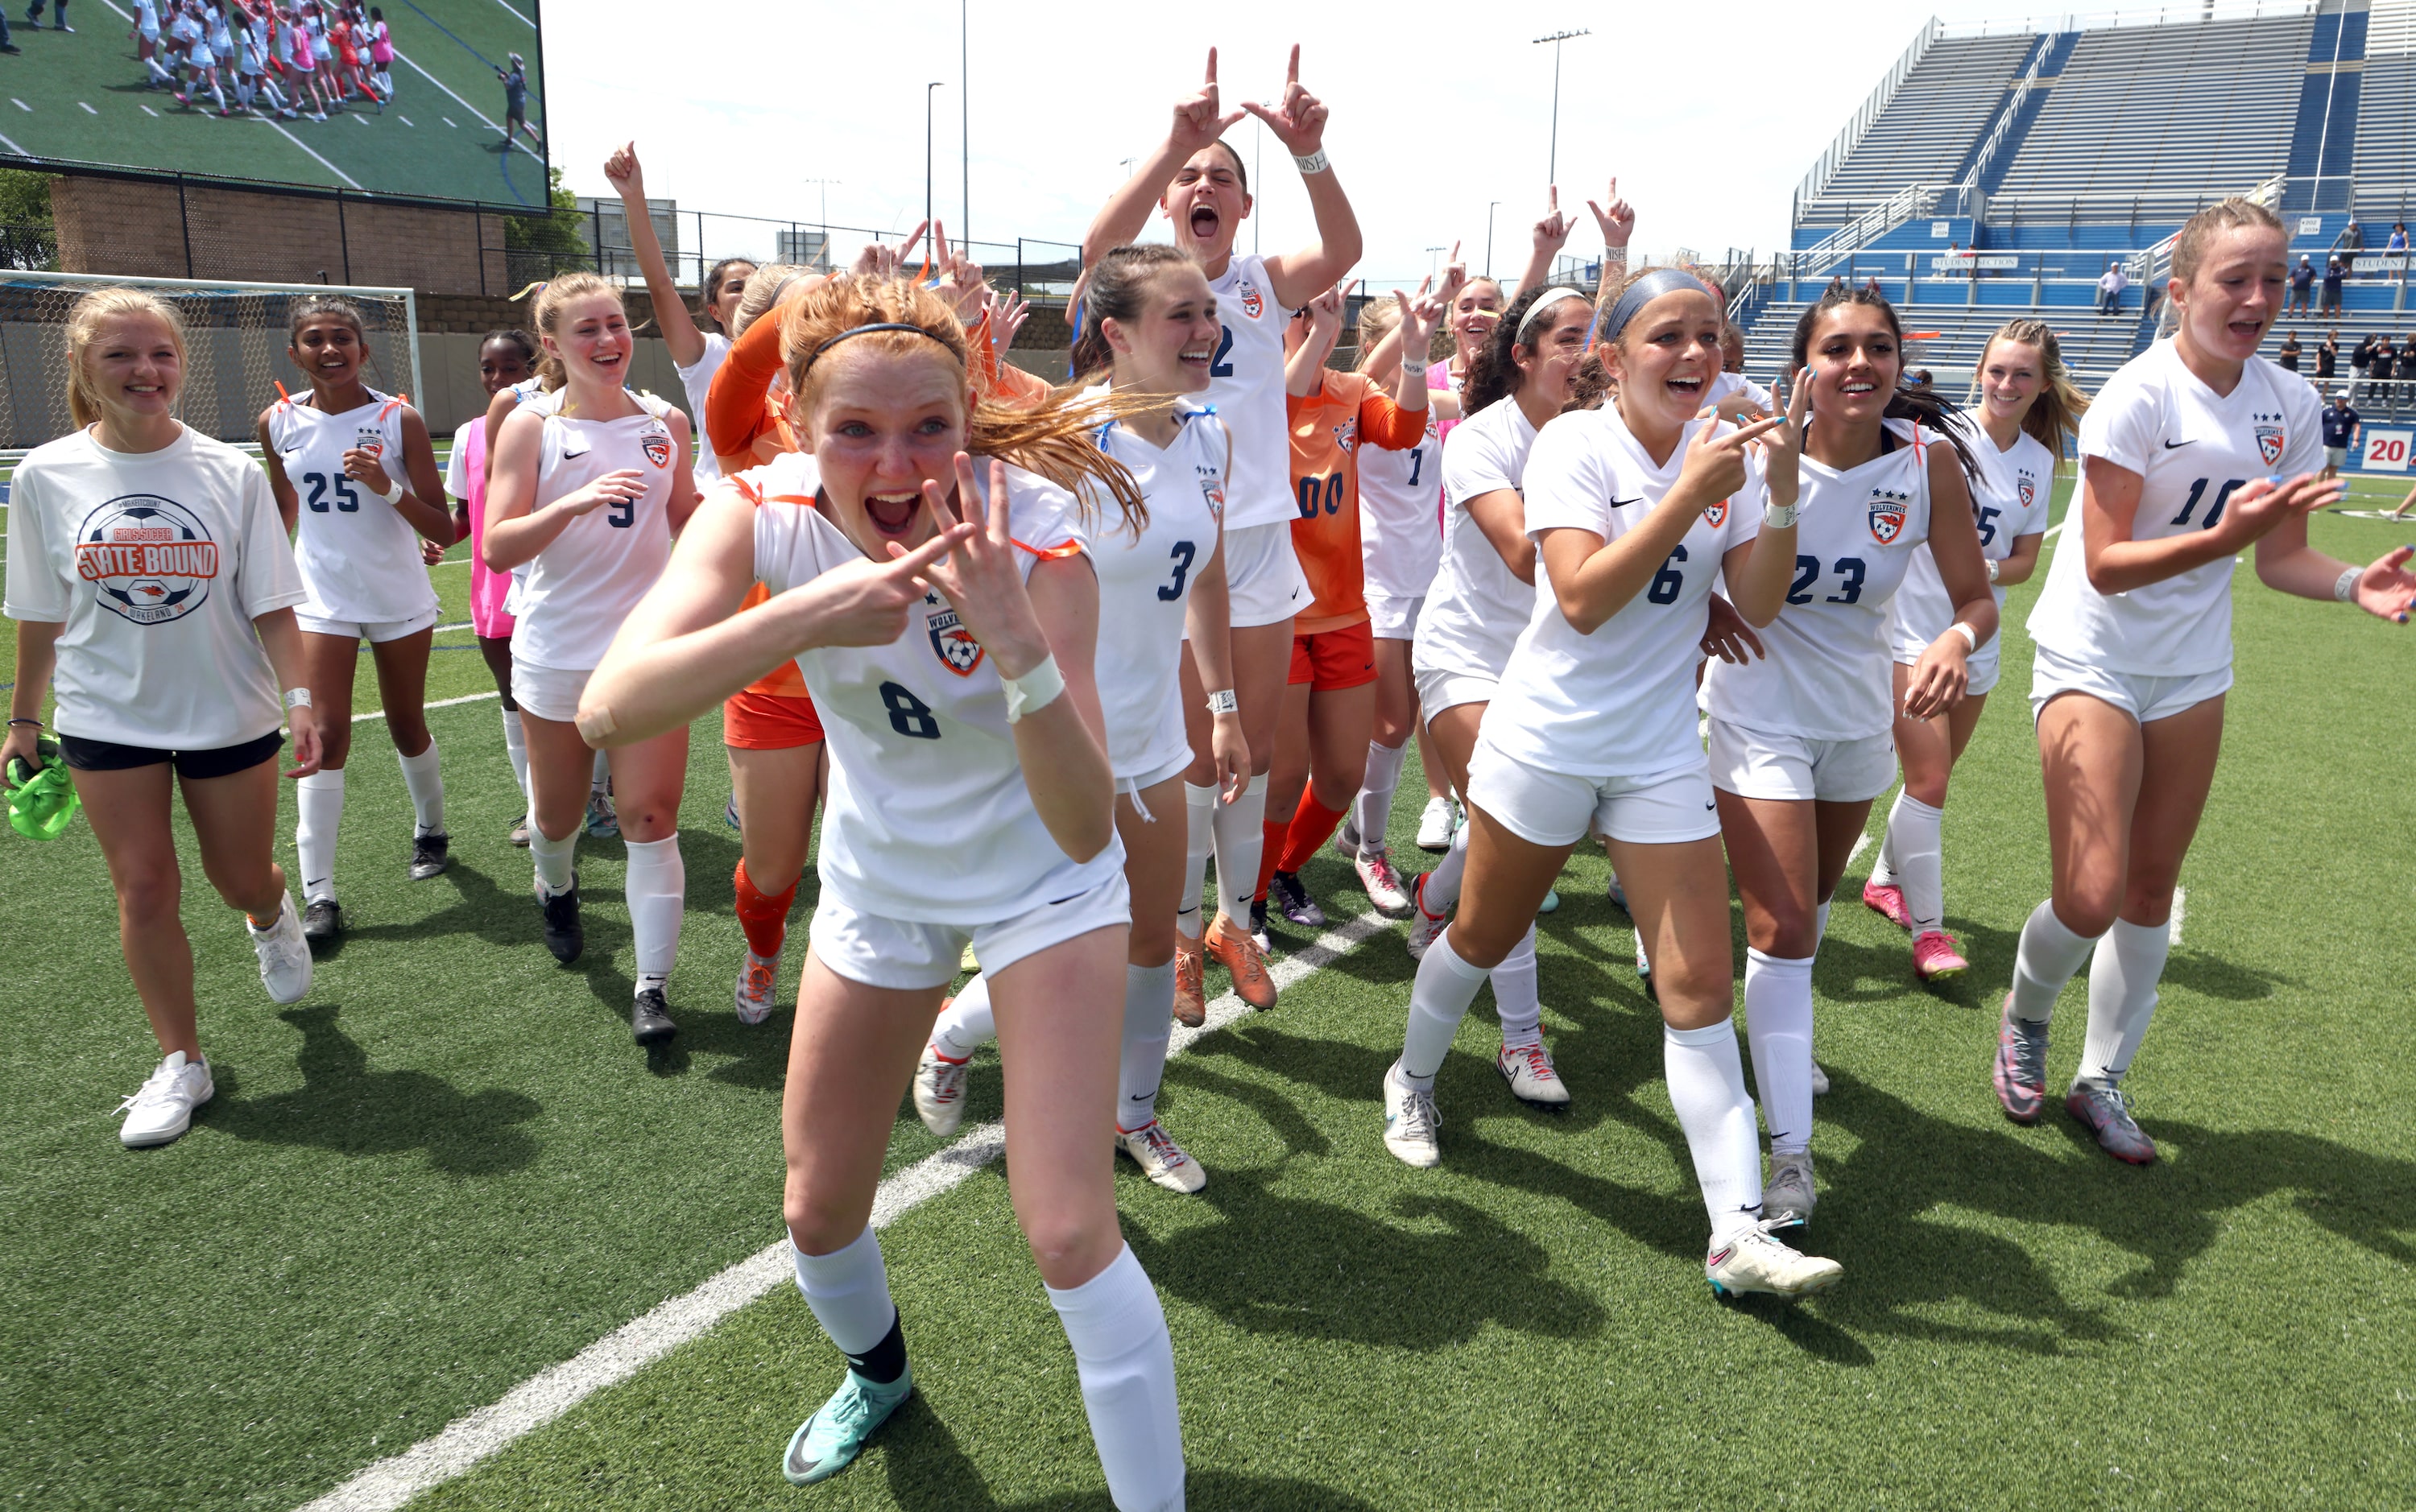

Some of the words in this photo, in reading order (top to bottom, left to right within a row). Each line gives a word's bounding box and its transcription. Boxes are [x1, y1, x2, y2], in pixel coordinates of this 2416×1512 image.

[1934, 258, 1973, 266] STUDENT
[1210, 325, 1233, 378] 2
[1408, 448, 1422, 486] 7
[2369, 440, 2405, 461] 20
[118, 499, 161, 508] #MAKEITCOUNT
[303, 472, 359, 513] 25
[1299, 472, 1343, 518] 00
[1870, 504, 1906, 514] WOLVERINES
[114, 528, 139, 541] GIRLS
[140, 528, 173, 541] SOCCER
[1977, 506, 2002, 547] 5
[77, 545, 143, 579] STATE
[143, 544, 217, 576] BOUND
[1157, 541, 1196, 601] 3
[1648, 544, 1688, 605] 6
[1785, 555, 1866, 605] 23
[130, 607, 172, 621] WAKELAND
[879, 681, 941, 740] 8
